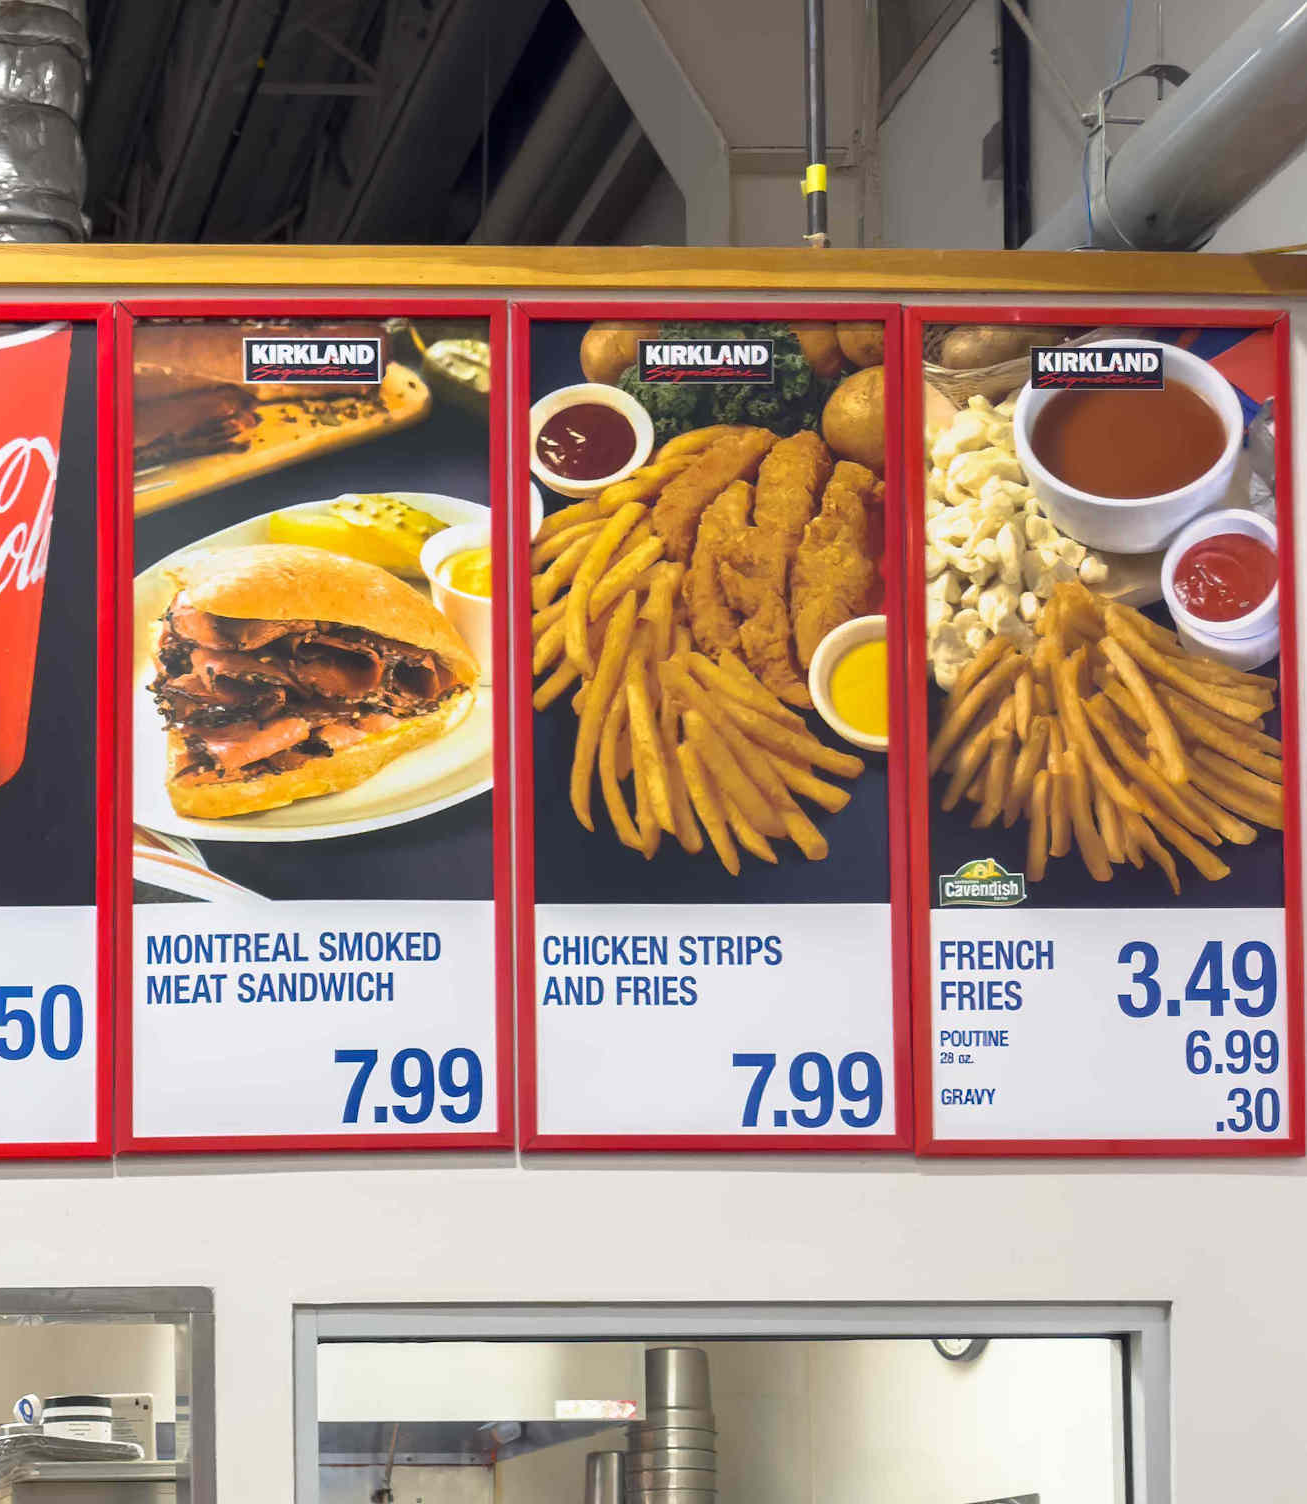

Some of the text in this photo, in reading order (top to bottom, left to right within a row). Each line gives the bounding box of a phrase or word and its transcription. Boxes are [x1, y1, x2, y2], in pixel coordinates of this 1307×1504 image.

[251, 344, 375, 365] KIRKLAND
[645, 345, 769, 366] KIRKLAND
[1038, 352, 1159, 373] KIRKLAND
[945, 880, 1019, 898] Cavendish
[147, 932, 441, 965] MONTREAL SMOKED
[543, 936, 782, 966] CHICKEN STRIPS
[940, 940, 1053, 970] FRENCH
[147, 972, 393, 1004] MEAT SANDWICH
[543, 976, 697, 1006] AND FRIES
[1117, 941, 1277, 1018] 3.49
[941, 981, 1022, 1011] FRIES
[940, 1030, 1009, 1047] POUTINE
[1186, 1030, 1279, 1074] 6.99
[940, 1052, 954, 1064] 28
[335, 1048, 483, 1124] 7.99
[733, 1052, 883, 1128] 7.99
[941, 1088, 996, 1105] GRAVY
[1217, 1088, 1280, 1132] .30
